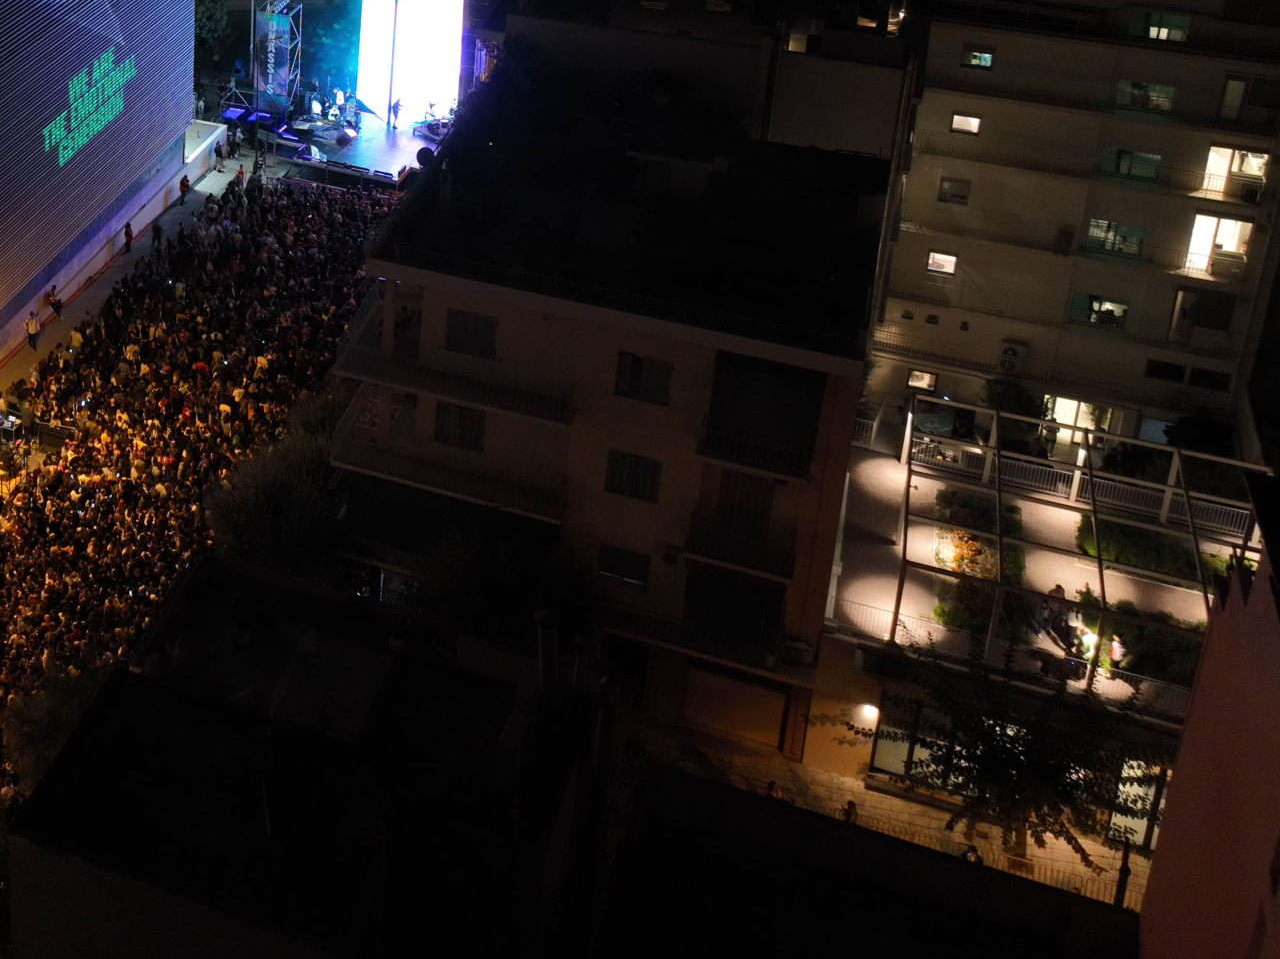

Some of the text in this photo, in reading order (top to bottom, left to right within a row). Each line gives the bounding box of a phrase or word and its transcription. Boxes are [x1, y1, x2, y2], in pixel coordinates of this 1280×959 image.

[68, 46, 115, 104] WE ARE
[266, 21, 276, 94] ONASSIS
[42, 54, 137, 152] THE EMOTIONAL
